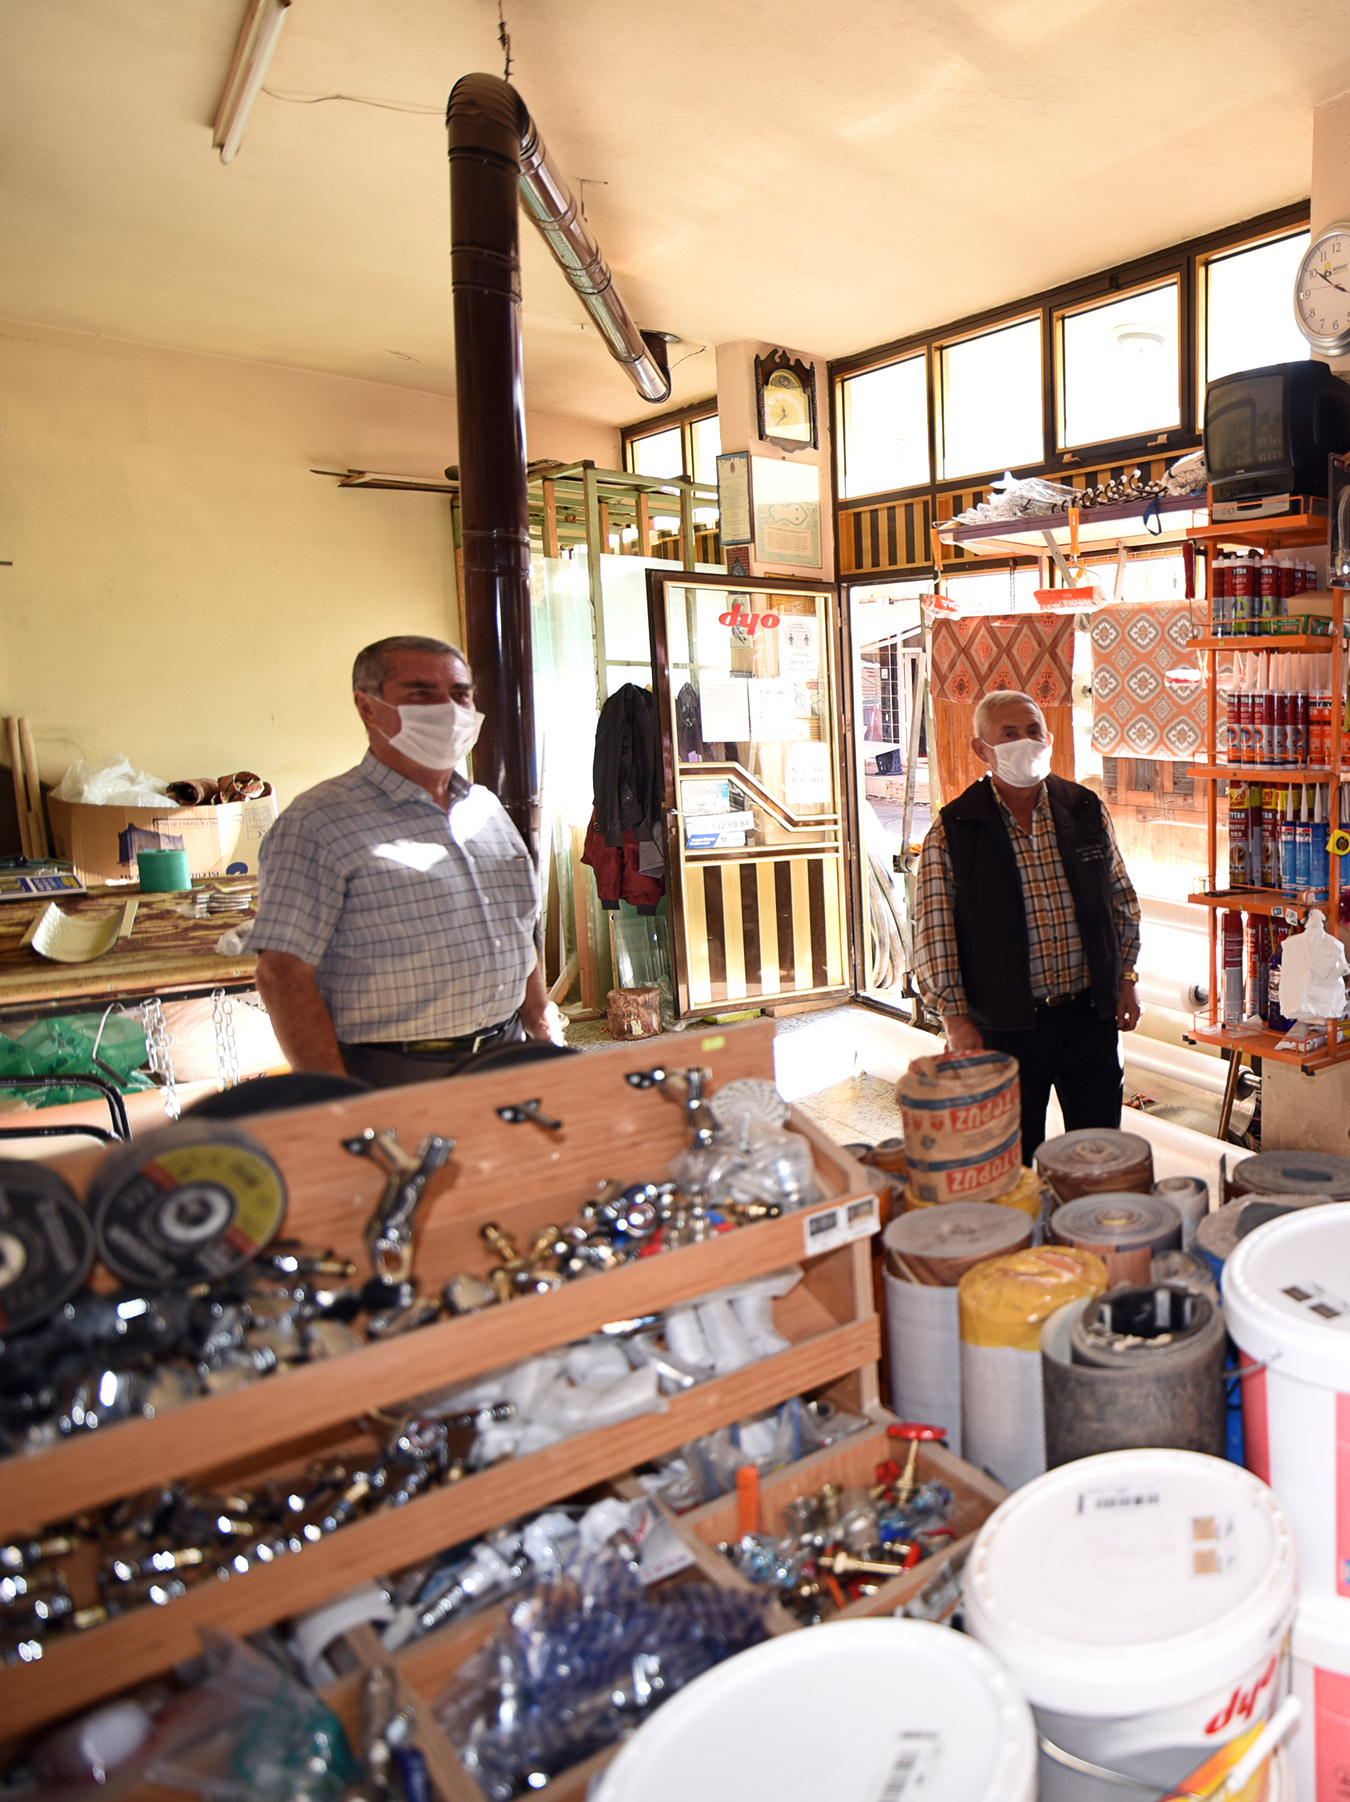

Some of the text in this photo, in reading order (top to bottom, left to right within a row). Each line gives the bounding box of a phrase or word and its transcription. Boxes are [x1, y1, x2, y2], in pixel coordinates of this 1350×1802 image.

[1332, 242, 1341, 254] 12
[1320, 251, 1327, 262] 11
[1309, 268, 1317, 279] 10
[1304, 289, 1311, 300] 9
[1309, 307, 1315, 318] 8
[1319, 318, 1325, 329] 7
[1332, 320, 1339, 331] 6
[718, 603, 780, 636] dyo
[728, 819, 738, 828] 69
[739, 819, 750, 827] 84
